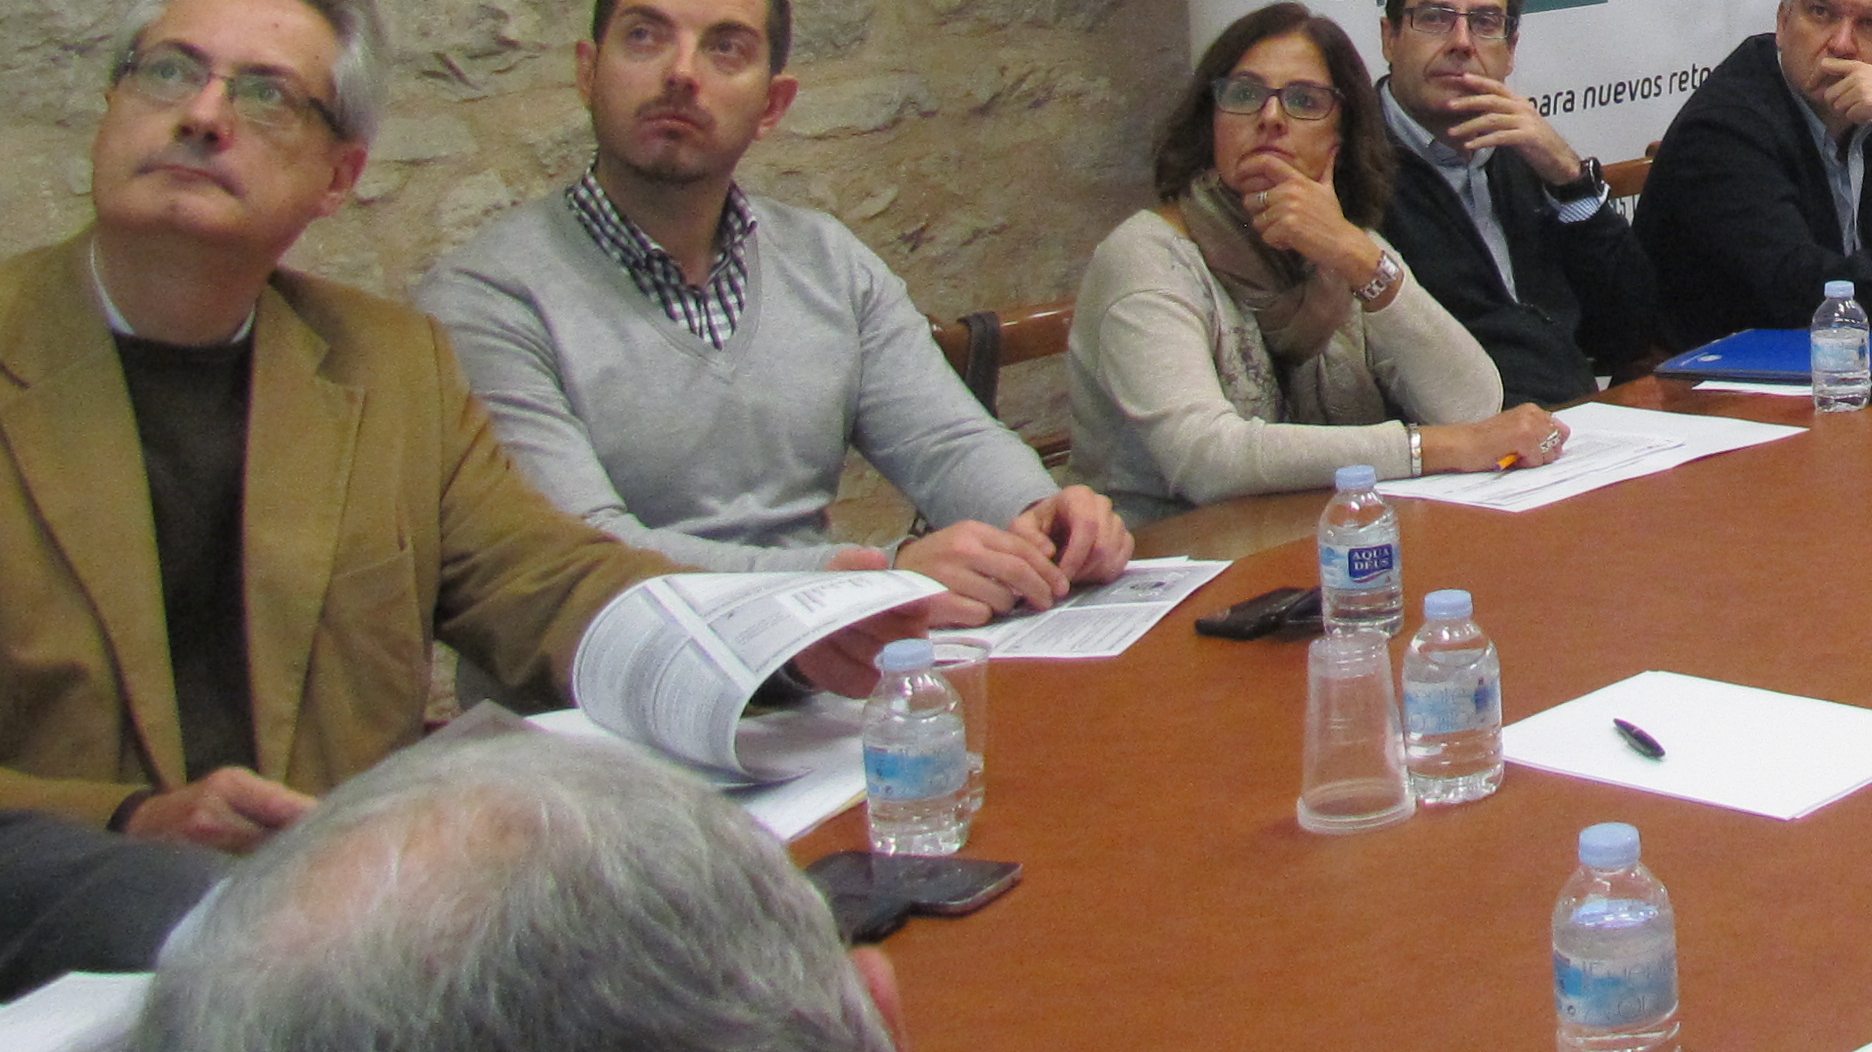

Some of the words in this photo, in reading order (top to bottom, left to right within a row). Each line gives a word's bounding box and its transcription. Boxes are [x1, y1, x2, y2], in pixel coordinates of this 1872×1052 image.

[1583, 74, 1663, 110] nuevos
[1668, 62, 1712, 96] reto
[1353, 548, 1390, 561] AQUA
[1354, 557, 1390, 570] DEUS
